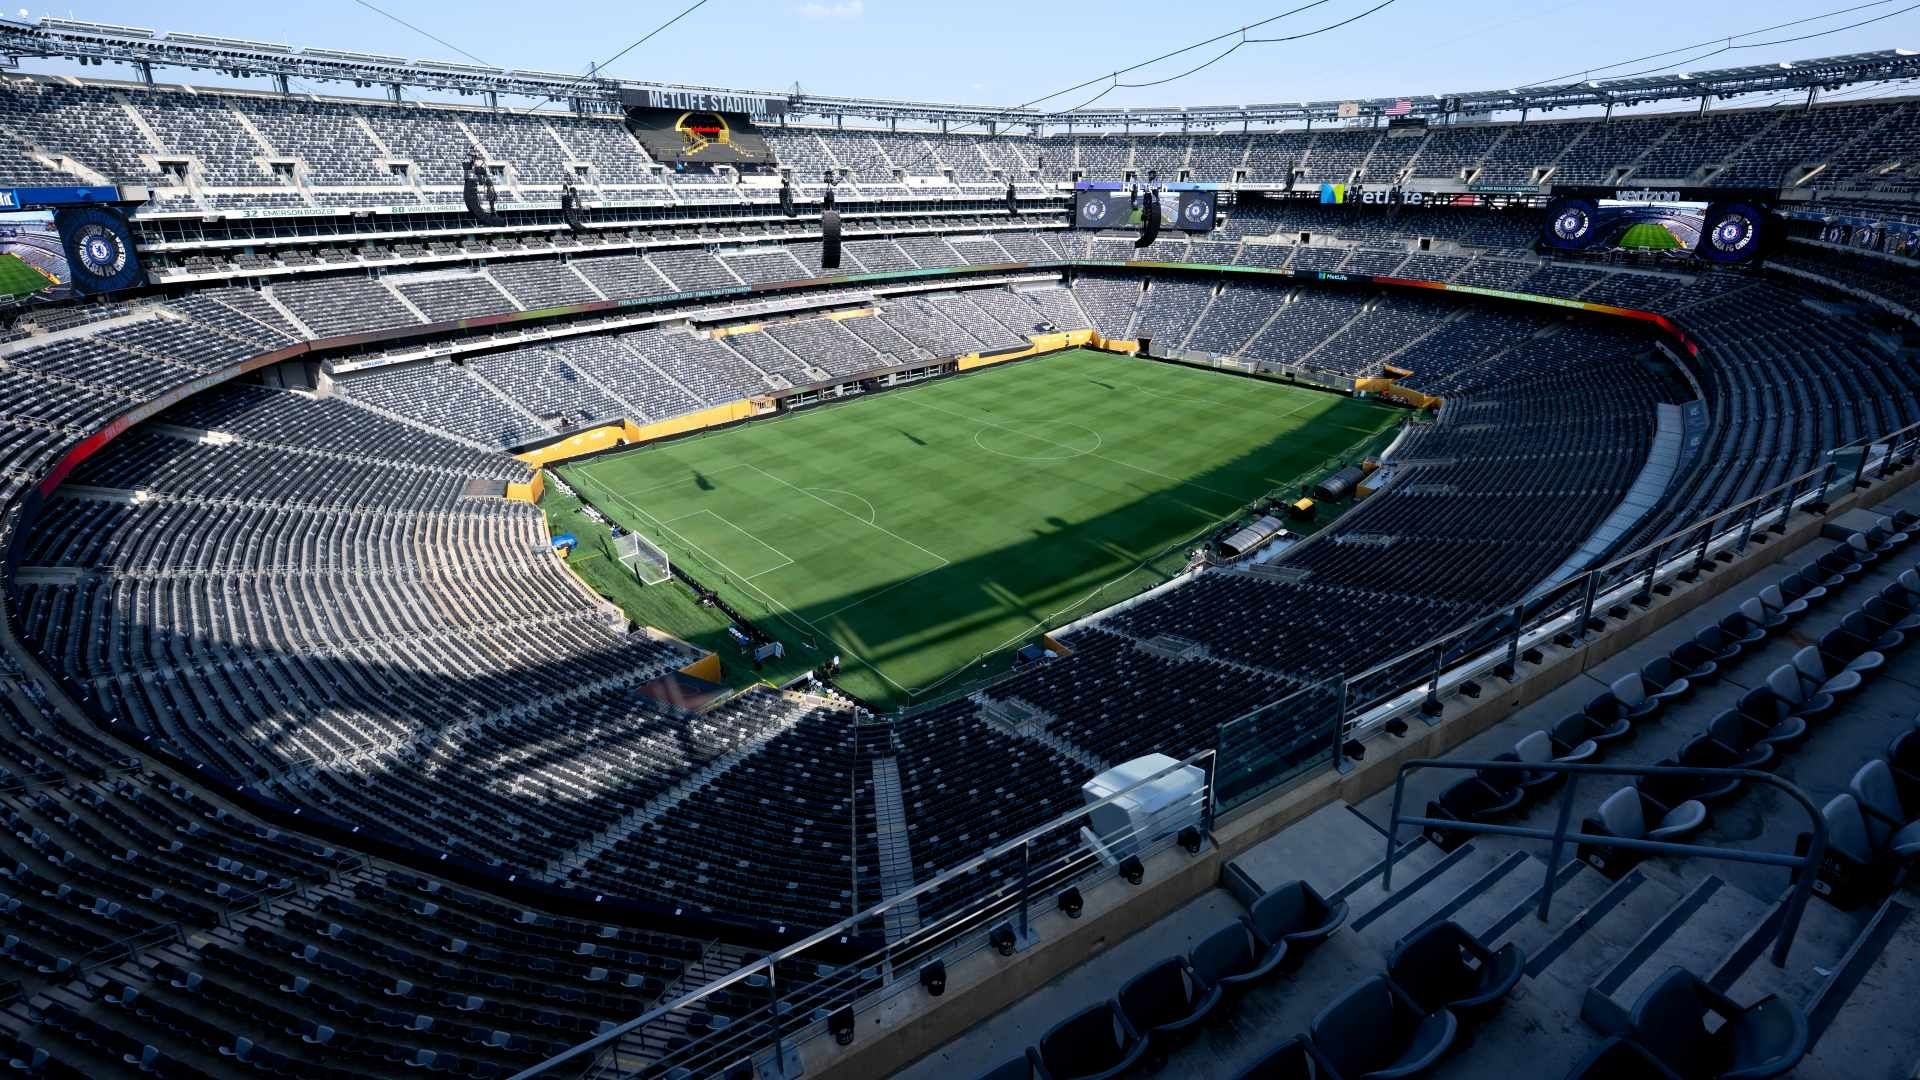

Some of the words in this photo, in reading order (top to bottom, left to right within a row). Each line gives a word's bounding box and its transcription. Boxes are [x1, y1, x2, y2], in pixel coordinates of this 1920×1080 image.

[648, 90, 707, 111] METLIFE
[710, 94, 767, 114] STADIUM
[1615, 188, 1681, 202] verizon
[243, 210, 259, 218] 32
[1326, 273, 1348, 281] MetLife
[647, 295, 667, 303] WORLD
